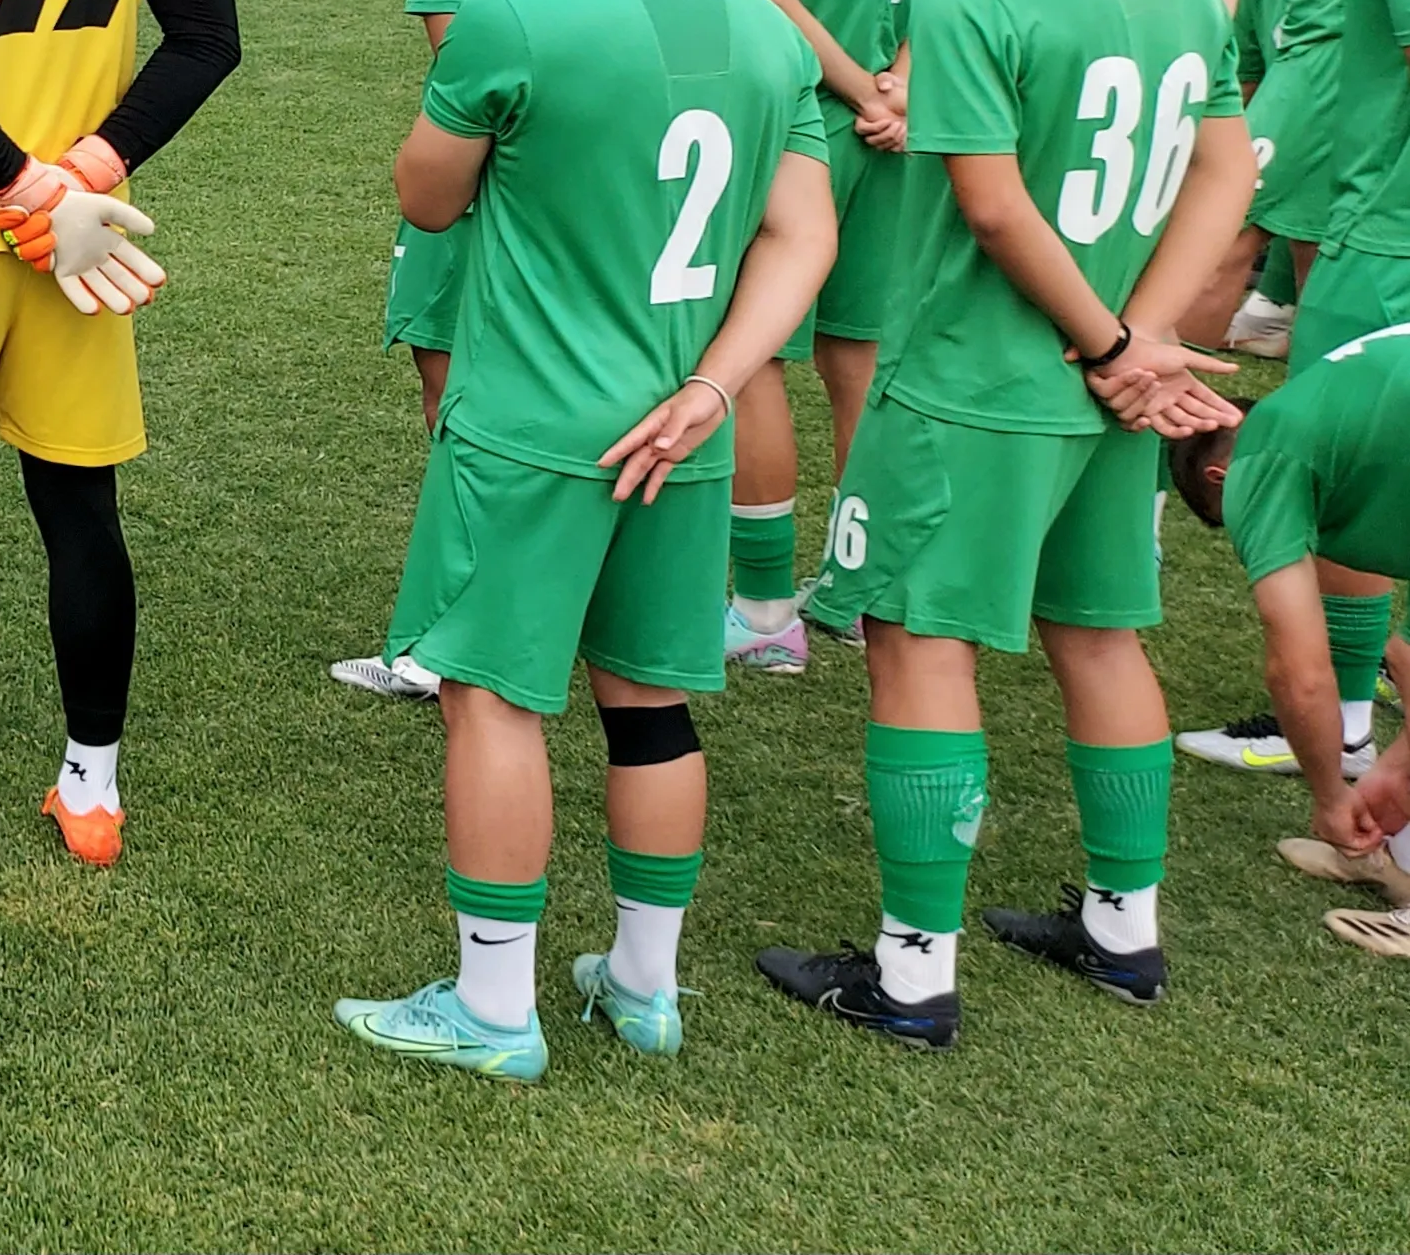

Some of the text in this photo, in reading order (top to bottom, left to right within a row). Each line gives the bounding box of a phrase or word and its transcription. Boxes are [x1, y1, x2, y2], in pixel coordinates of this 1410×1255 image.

[649, 108, 734, 305] 2
[1057, 51, 1209, 245] 36
[822, 485, 870, 571] 6
